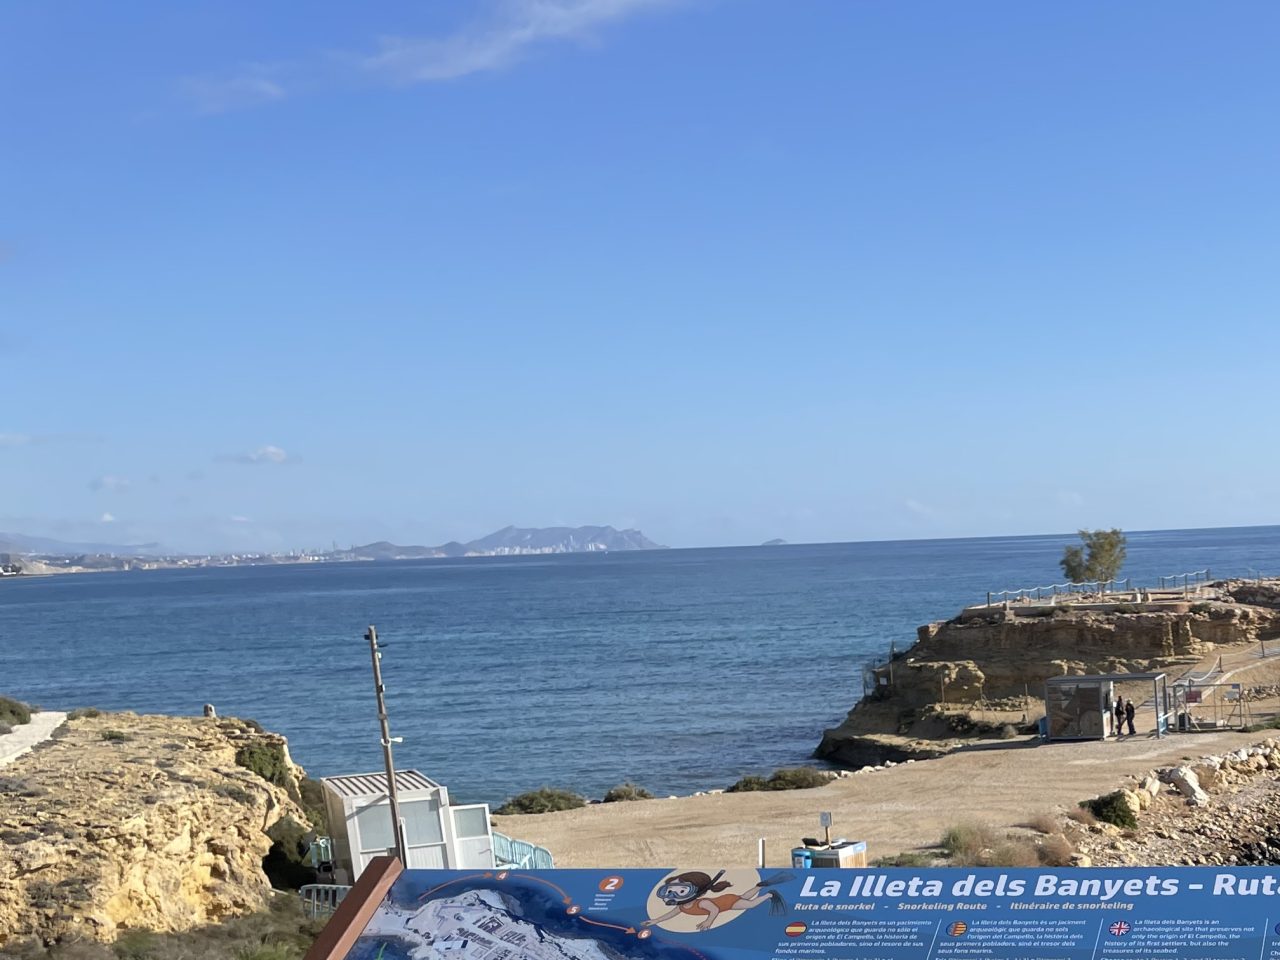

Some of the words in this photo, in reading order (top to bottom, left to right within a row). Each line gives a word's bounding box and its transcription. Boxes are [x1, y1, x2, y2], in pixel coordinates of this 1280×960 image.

[604, 878, 619, 890] 2
[799, 876, 841, 898] La
[848, 875, 944, 897] Illeta
[951, 874, 1027, 897] dels
[1034, 874, 1179, 902] Banyets
[571, 906, 578, 914] 5
[794, 902, 819, 911] Ruta
[821, 902, 834, 911] de
[835, 902, 876, 911] snorkel
[897, 902, 955, 912] Snorkeling
[956, 902, 988, 911] Route
[1009, 901, 1060, 911] Itinéraire
[1061, 901, 1076, 911] de
[1076, 901, 1135, 912] snorkeling
[641, 930, 649, 938] 6
